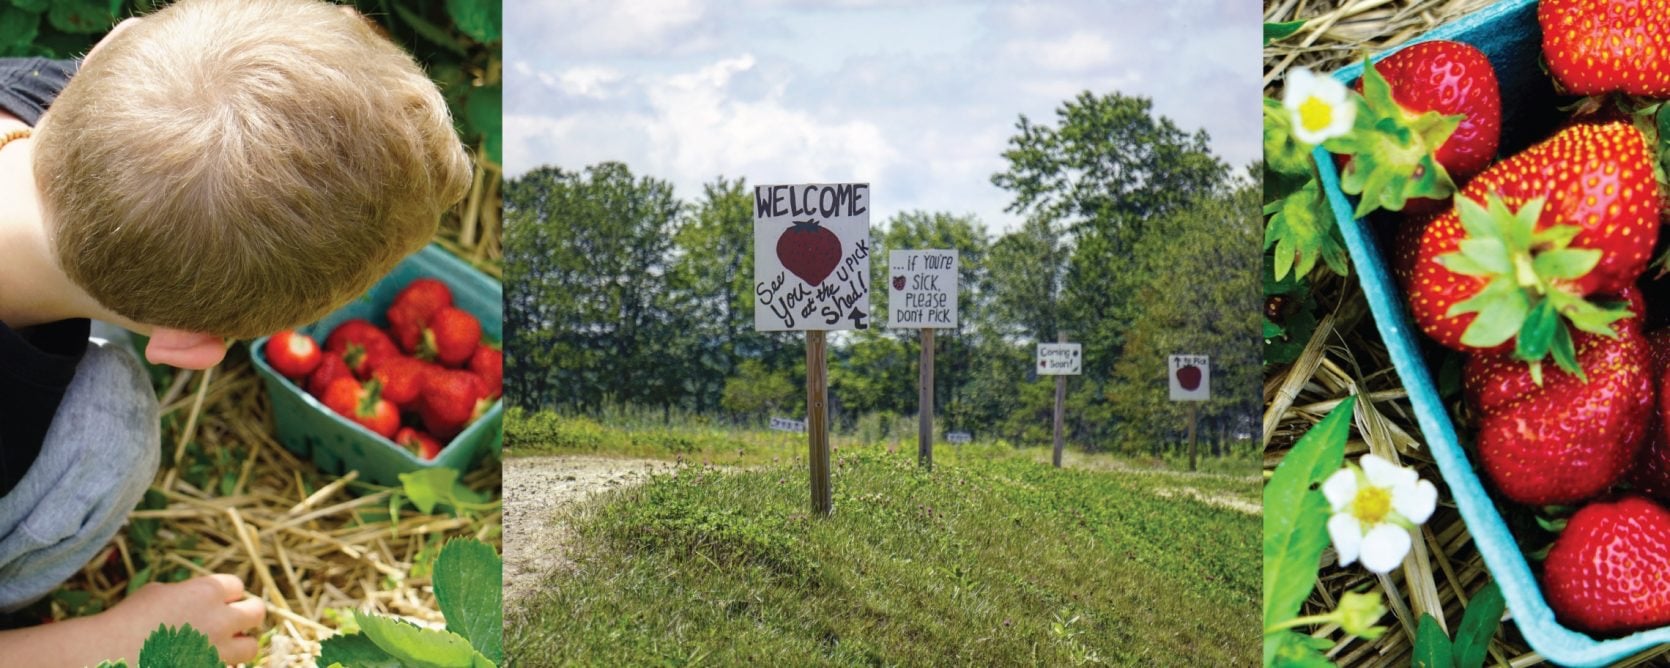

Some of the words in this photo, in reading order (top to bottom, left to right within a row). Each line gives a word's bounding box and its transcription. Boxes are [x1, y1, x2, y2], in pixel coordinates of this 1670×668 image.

[755, 184, 867, 218] WELCOME
[757, 271, 785, 305] See
[801, 298, 817, 318] at
[816, 281, 840, 302] the
[821, 271, 867, 325] Shed!
[1041, 347, 1070, 359] Coming
